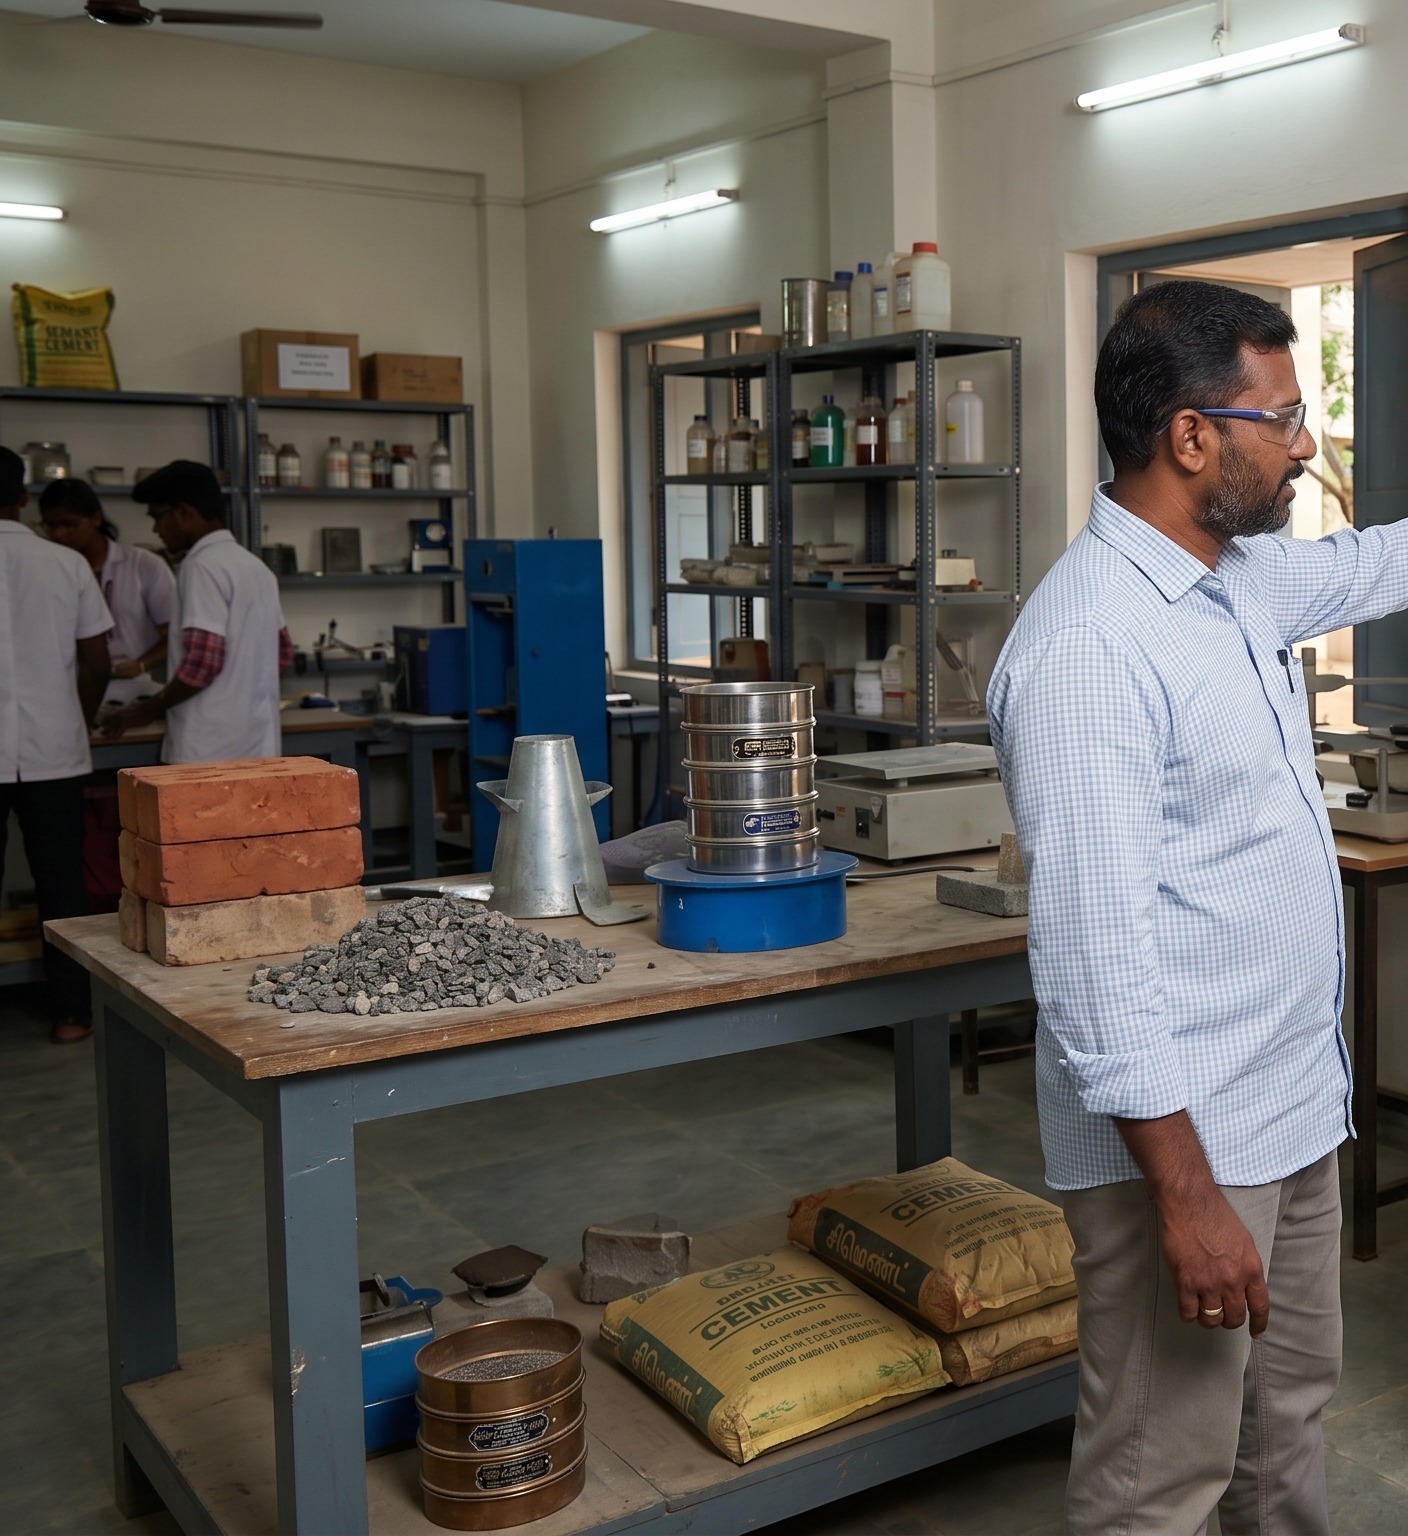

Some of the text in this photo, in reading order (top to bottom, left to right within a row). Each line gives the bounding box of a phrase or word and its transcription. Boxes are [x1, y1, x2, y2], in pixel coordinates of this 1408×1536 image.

[45, 339, 99, 352] CEMENT
[891, 1181, 1015, 1221] CEMENT
[701, 1281, 844, 1341] CEMENT
